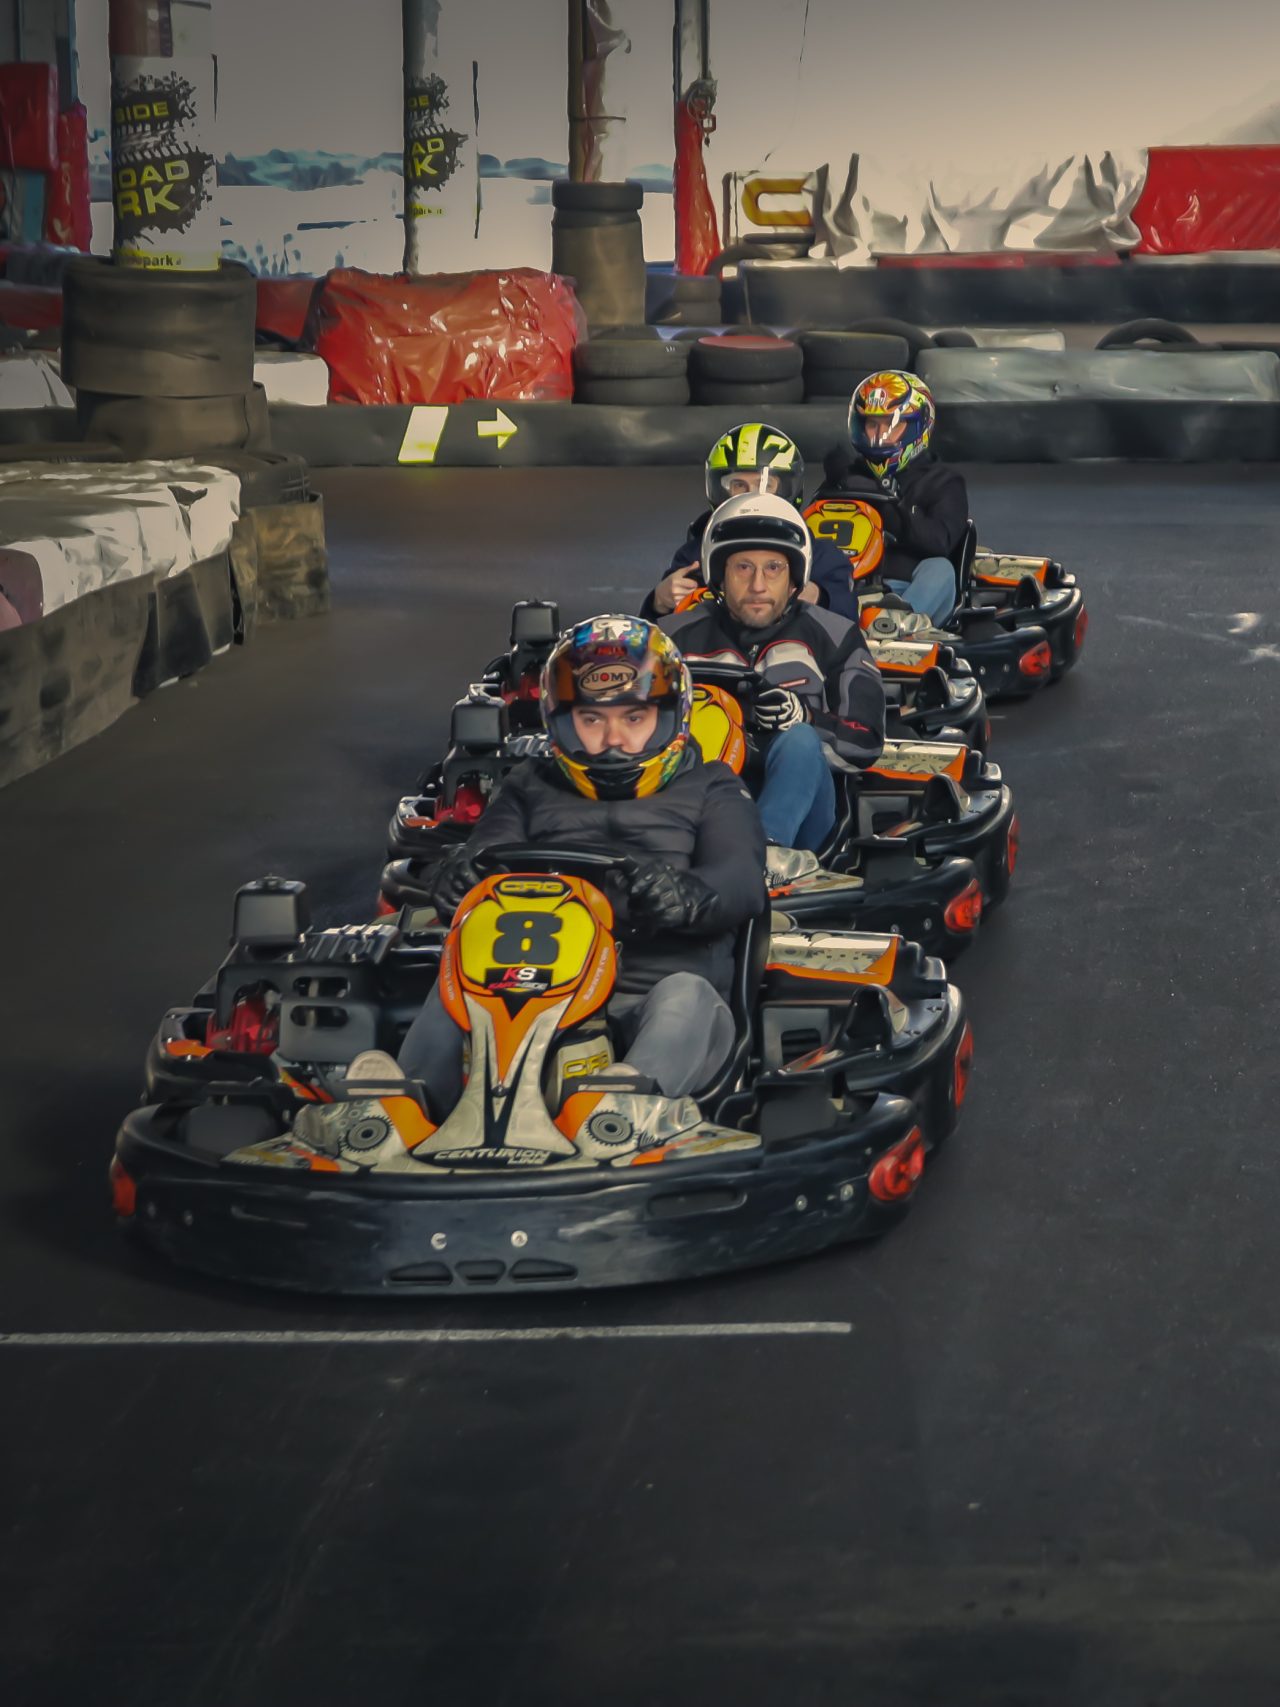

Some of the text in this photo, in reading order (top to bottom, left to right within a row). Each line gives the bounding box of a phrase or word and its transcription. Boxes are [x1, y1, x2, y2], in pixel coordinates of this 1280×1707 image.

[584, 672, 633, 684] SUOMY
[499, 880, 564, 893] CRG
[492, 910, 564, 965] 8
[503, 966, 538, 981] KS
[433, 1147, 551, 1161] CENTURION
